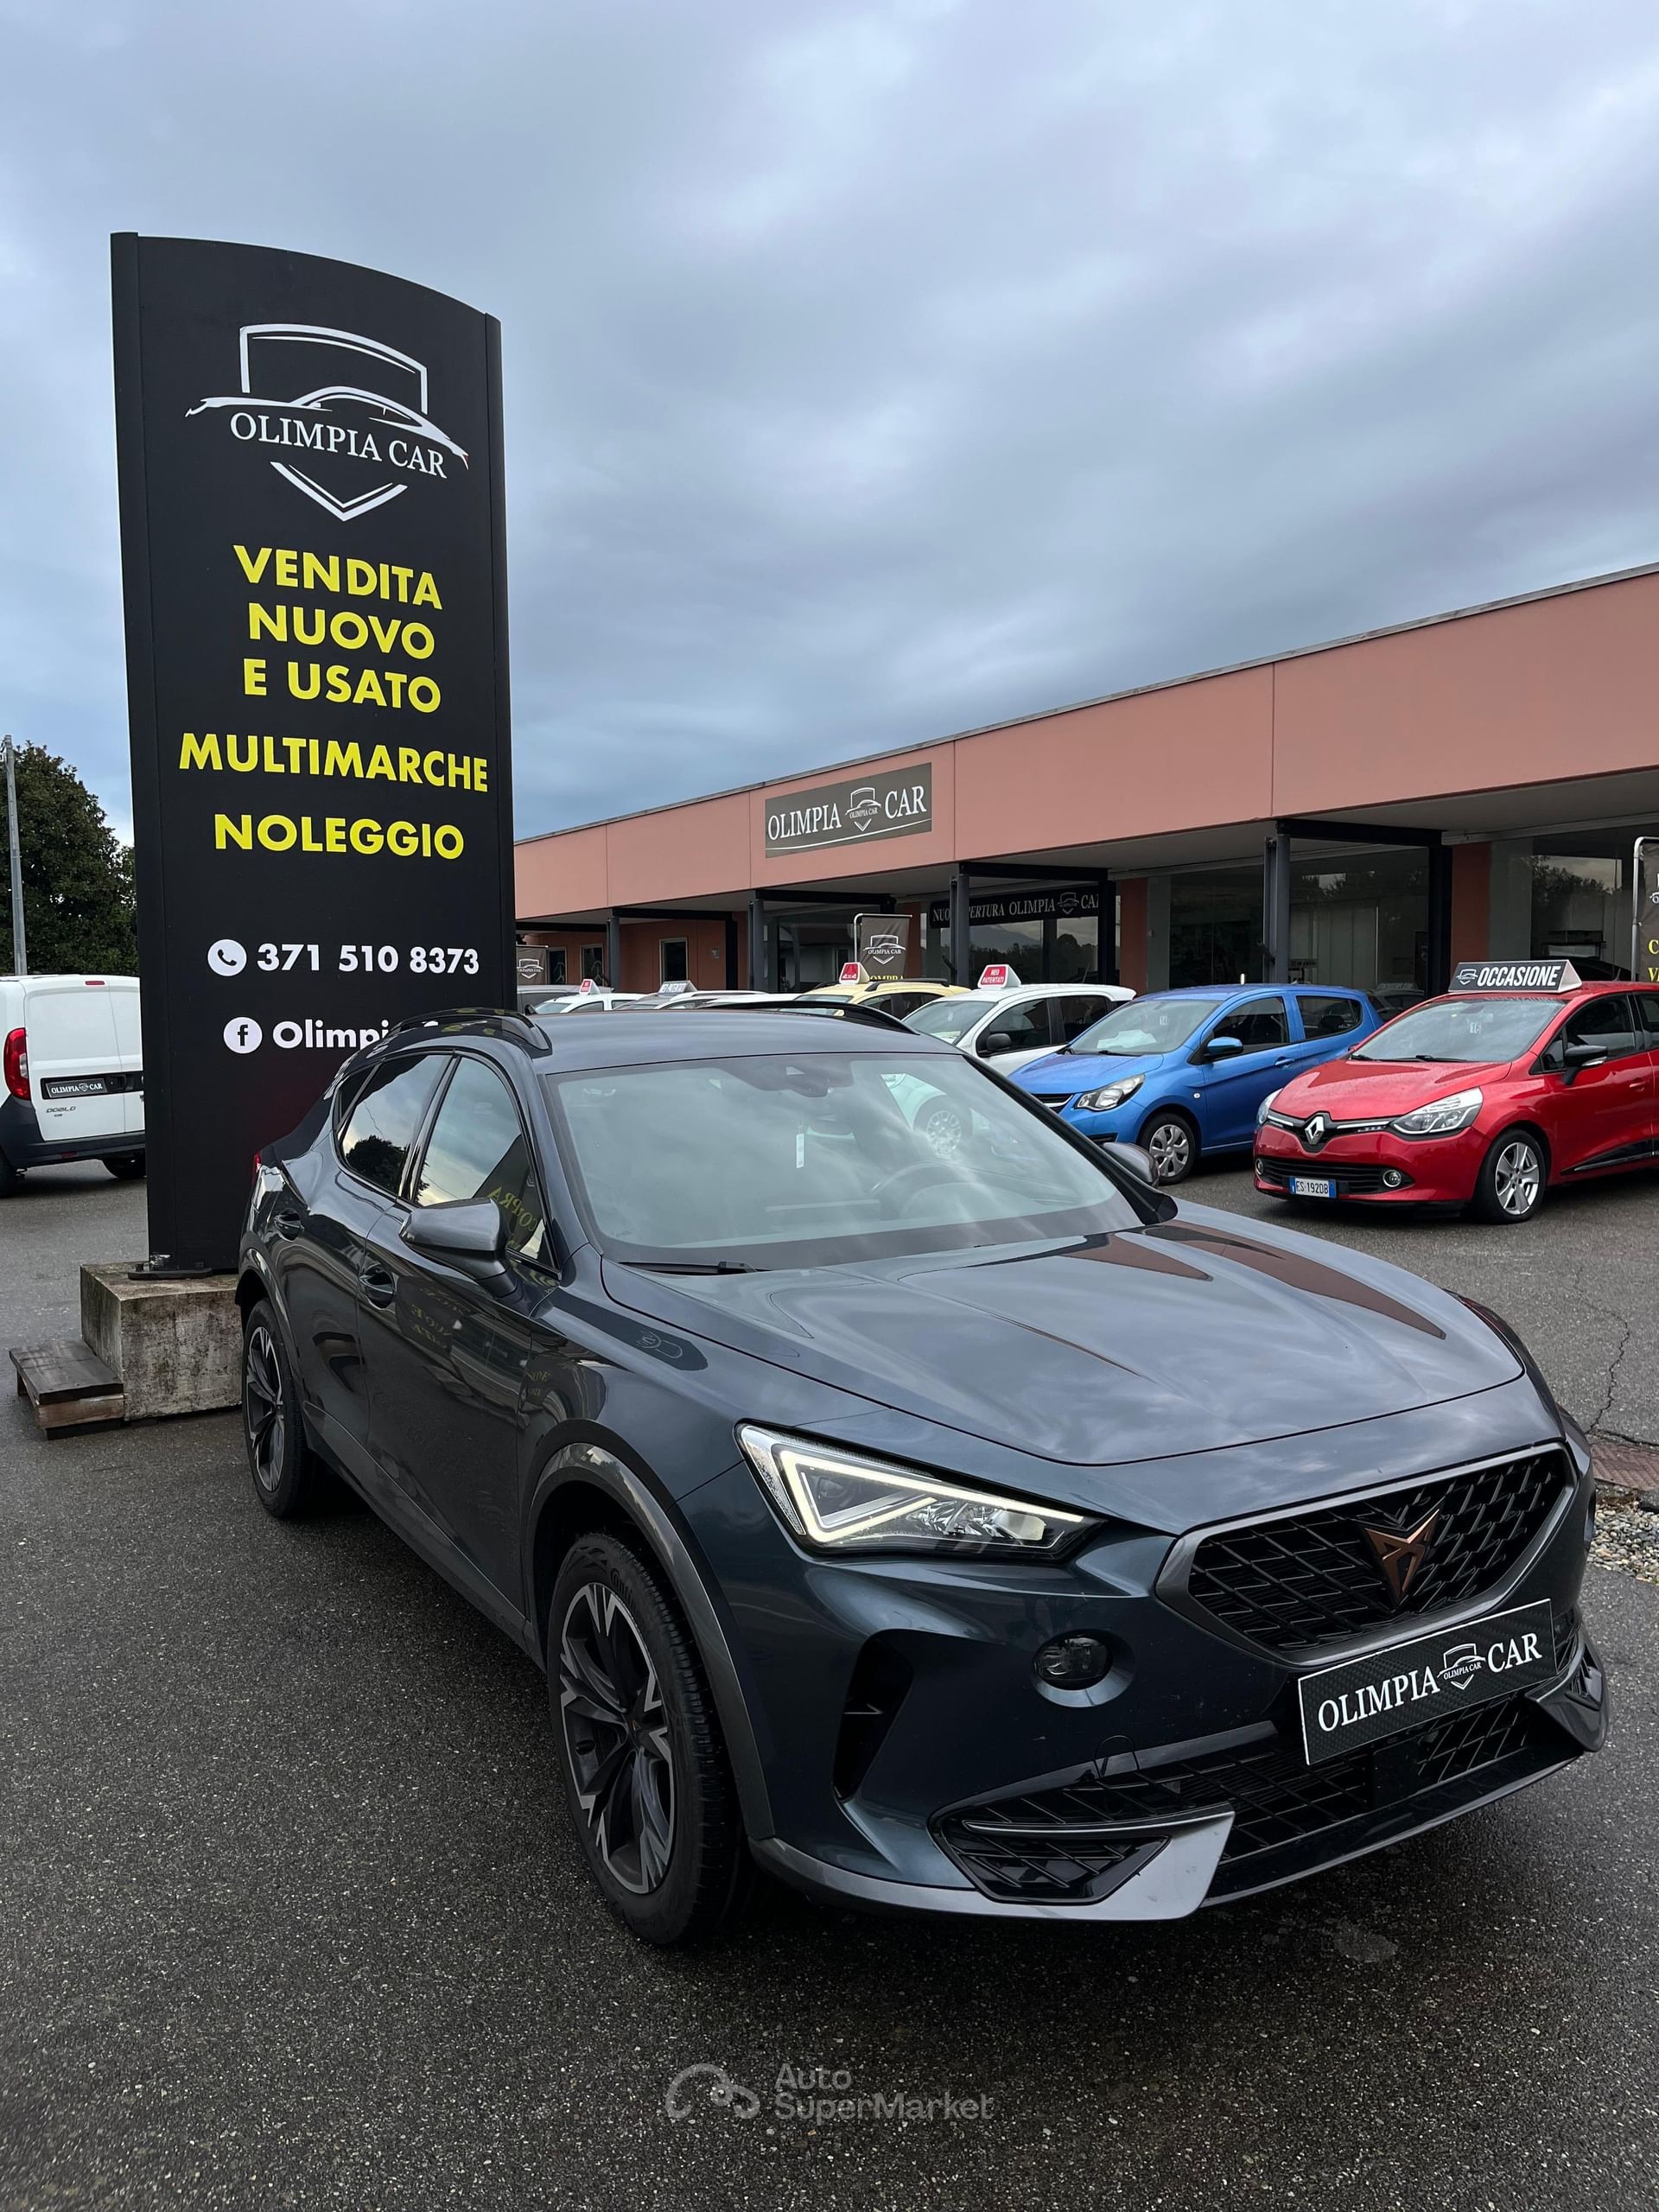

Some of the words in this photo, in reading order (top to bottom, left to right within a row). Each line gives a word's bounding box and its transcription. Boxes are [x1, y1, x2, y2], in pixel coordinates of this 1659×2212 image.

[230, 412, 383, 462] OLIMPIA
[388, 440, 448, 479] CAR
[232, 544, 443, 610] VENDITA
[248, 602, 435, 659] NUOVO
[243, 658, 267, 696] E
[287, 661, 442, 713] USATO
[179, 732, 488, 792] MULTIMARCHE
[214, 813, 464, 860] NOLEGGIO
[767, 803, 842, 841] OLIMPIA
[884, 785, 927, 819] CAR
[849, 809, 868, 819] OLIMPIA
[868, 807, 879, 816] CAR
[932, 909, 950, 922] NUO
[1008, 898, 1056, 916] OLIMPIA
[1081, 893, 1099, 910] CA
[257, 943, 320, 971] 371
[338, 944, 399, 973] 510
[410, 946, 480, 975] 8373
[1477, 965, 1561, 987] OCCASIONE
[51, 1085, 79, 1094] OLIMPIA
[1295, 1180, 1305, 1192] ES
[1318, 1665, 1441, 1732] OLIMPIA
[1487, 1632, 1543, 1673] CAR
[1443, 1666, 1470, 1681] OLIMPIA
[1469, 1662, 1482, 1672] CAR
